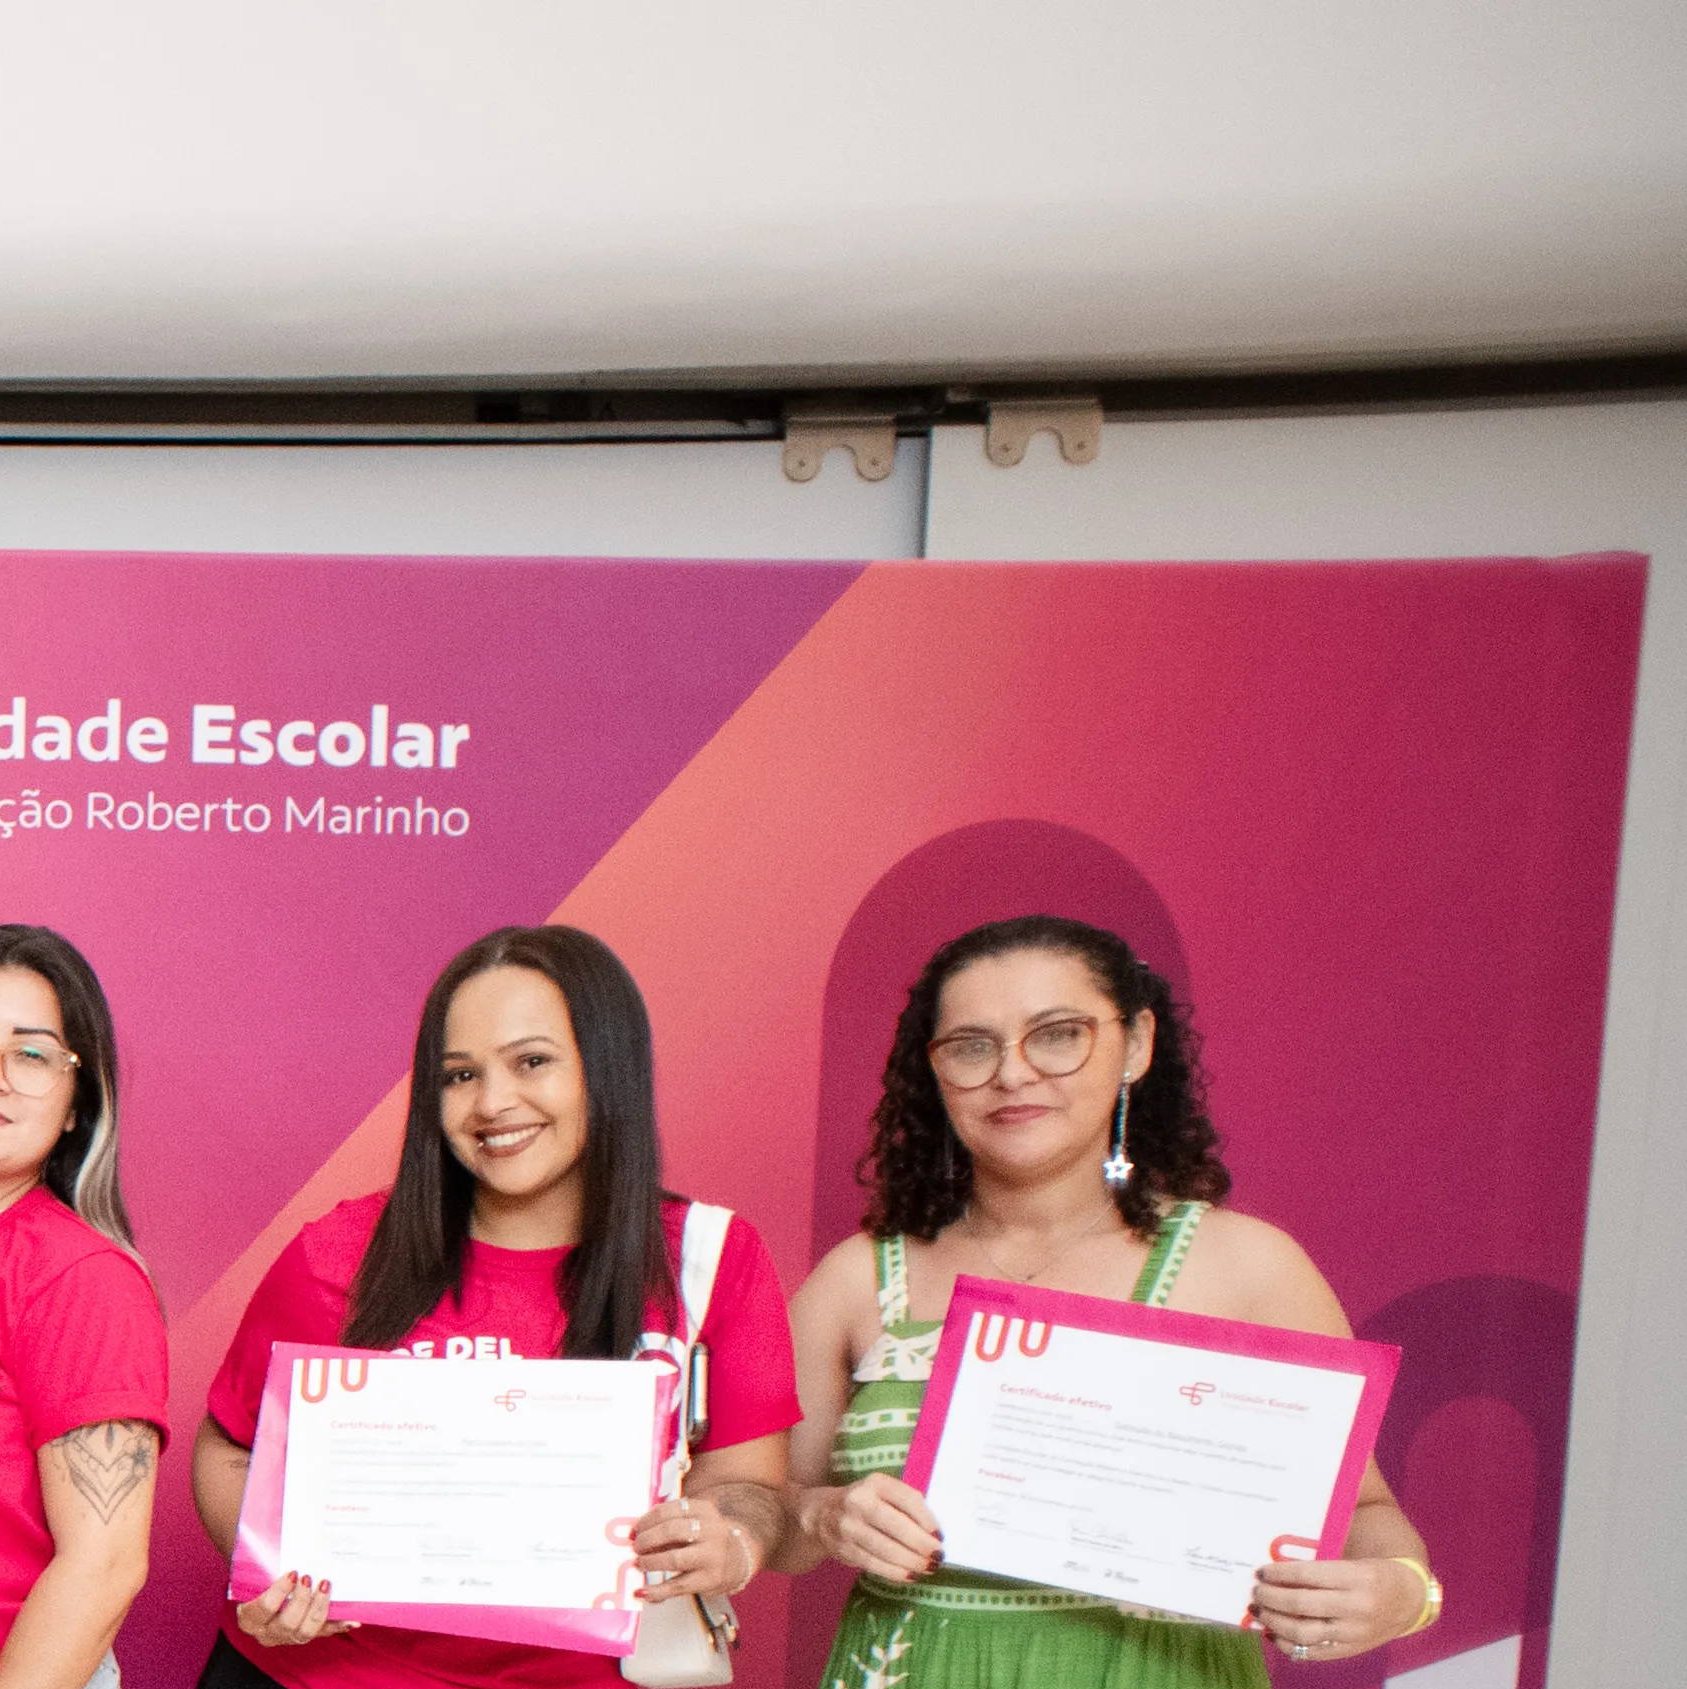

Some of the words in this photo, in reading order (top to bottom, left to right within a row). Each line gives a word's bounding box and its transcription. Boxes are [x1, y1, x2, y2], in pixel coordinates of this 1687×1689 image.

[191, 703, 471, 769] Escolar
[86, 790, 272, 834] Roberto
[284, 794, 470, 837] Marinho
[445, 1336, 524, 1360] DEL
